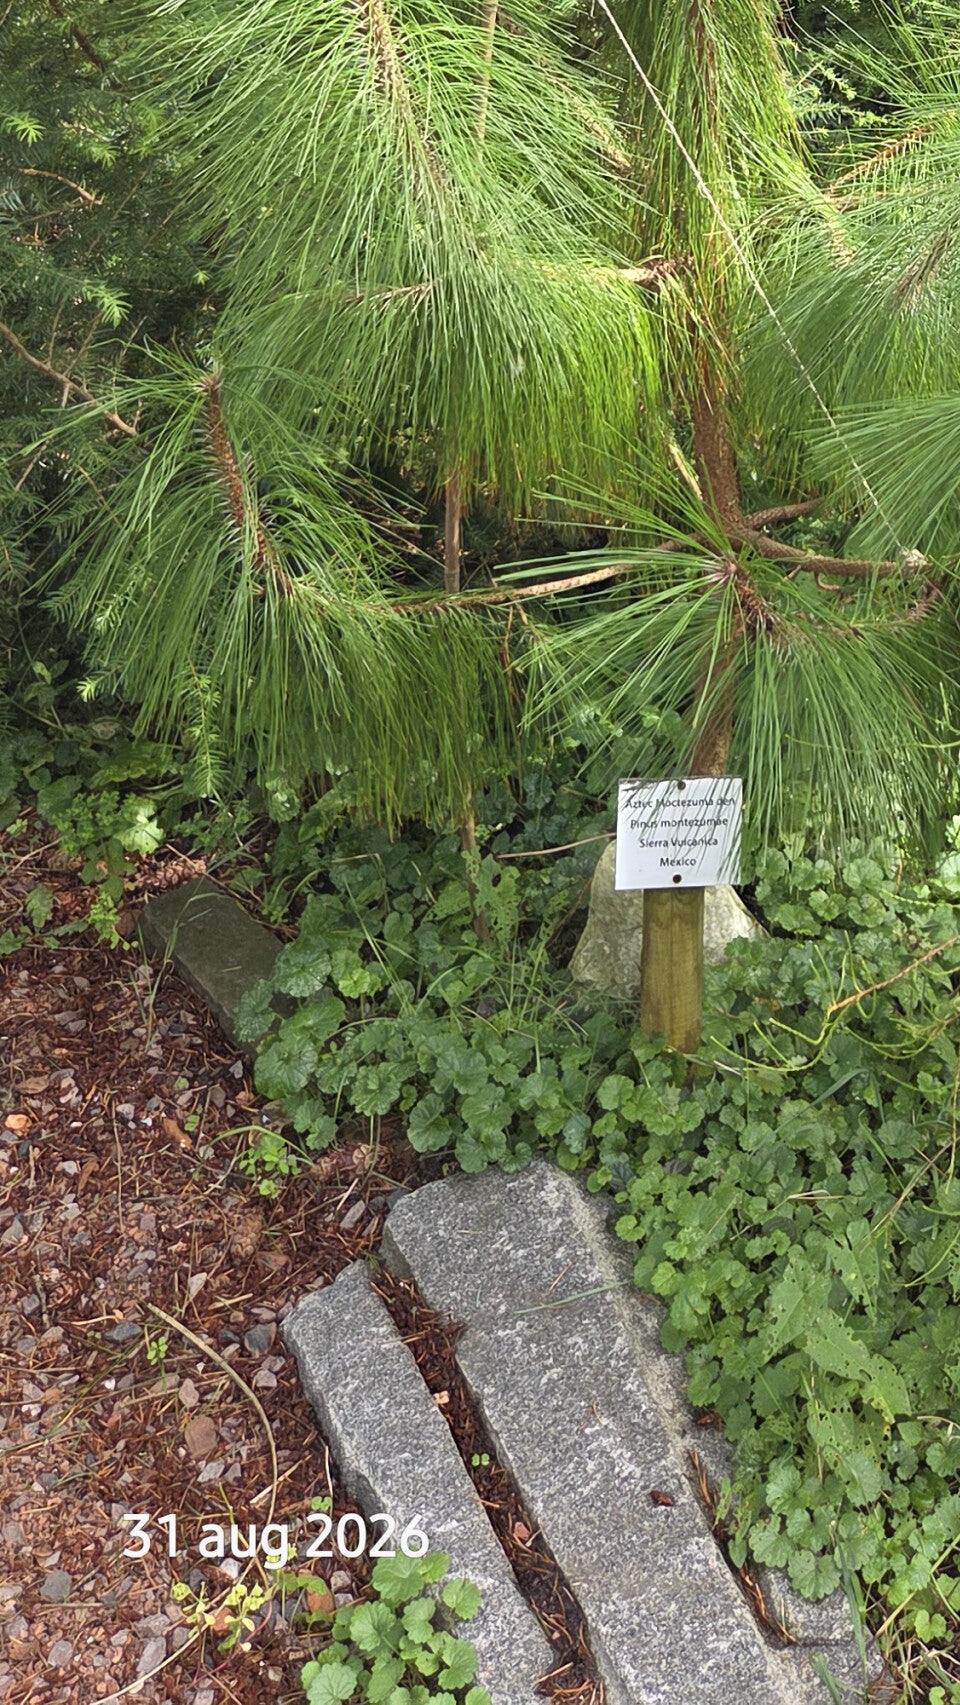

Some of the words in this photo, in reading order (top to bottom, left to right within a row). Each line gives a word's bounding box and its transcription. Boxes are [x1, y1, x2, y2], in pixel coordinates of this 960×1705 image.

[626, 798, 653, 809] Aztec
[656, 797, 714, 808] Moctezuma
[630, 819, 658, 829] Pinus
[660, 818, 728, 829] montezumae
[639, 838, 668, 849] Sierra
[659, 857, 697, 867] Mexico
